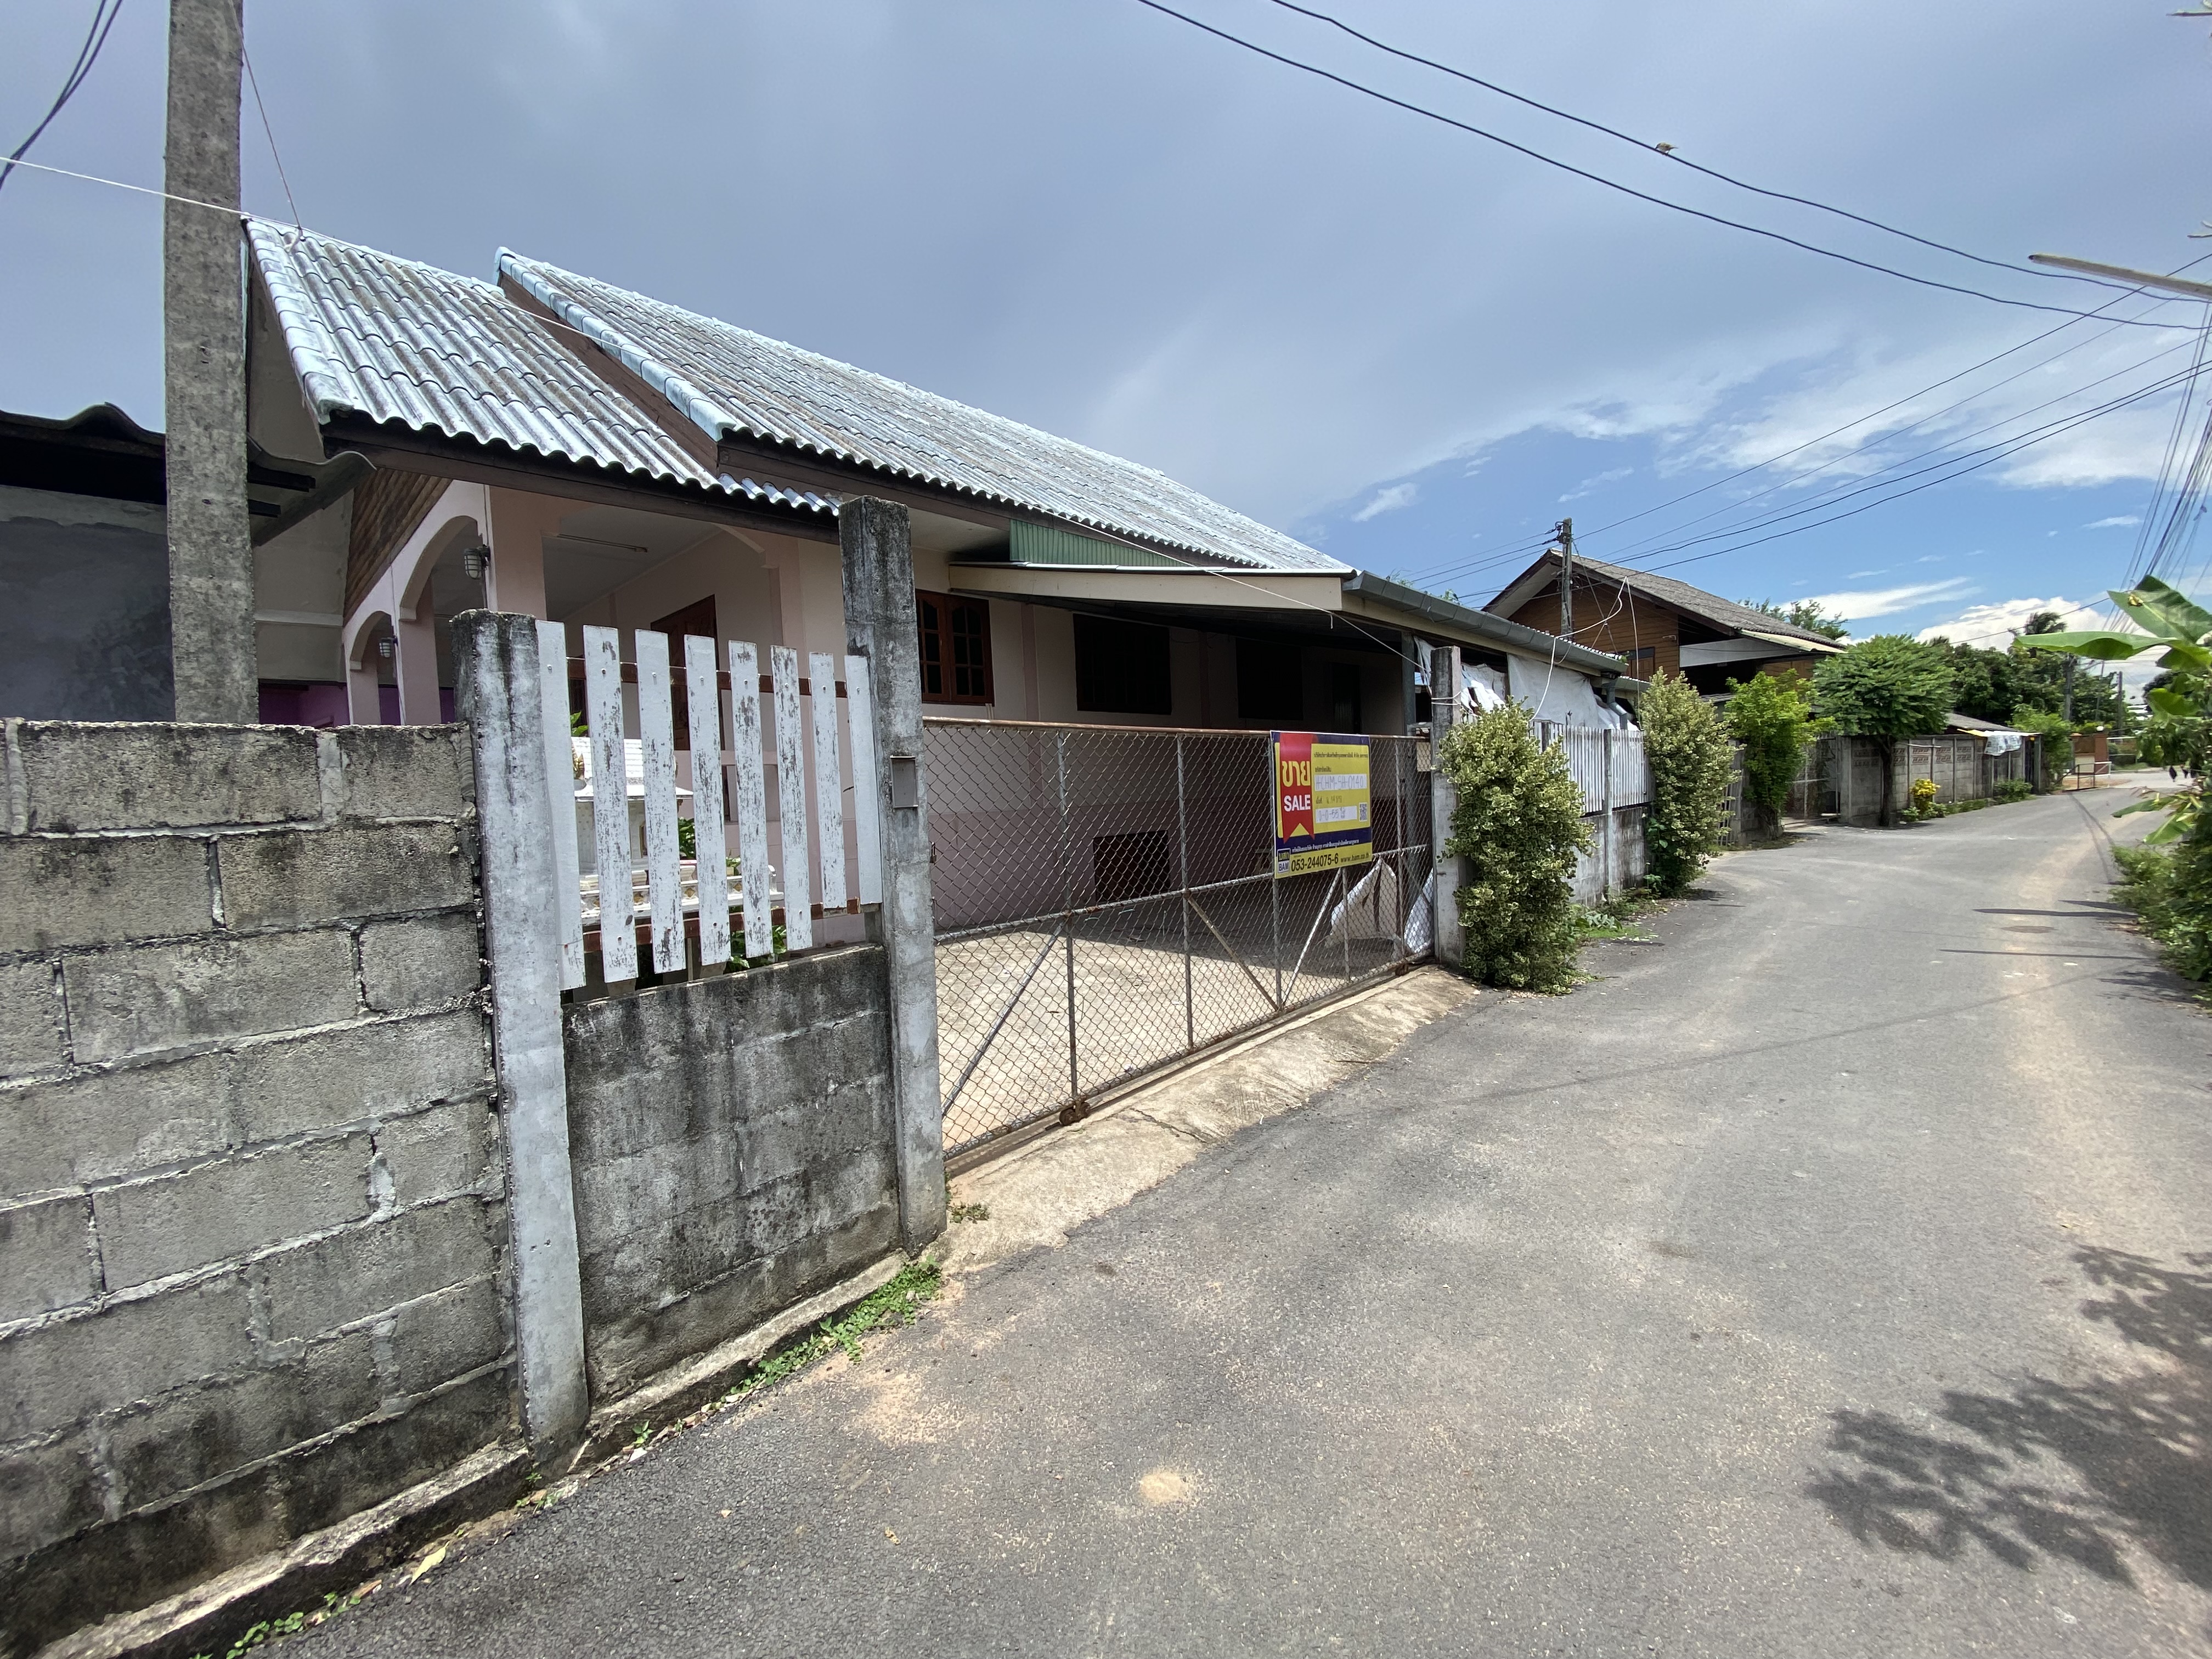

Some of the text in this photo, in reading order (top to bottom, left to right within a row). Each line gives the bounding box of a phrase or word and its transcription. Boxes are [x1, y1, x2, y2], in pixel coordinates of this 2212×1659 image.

[1282, 760, 1311, 787] ขาย
[1284, 794, 1311, 812] SALE
[1279, 862, 1289, 871] BAM
[1291, 853, 1339, 872] 053-244075-6
